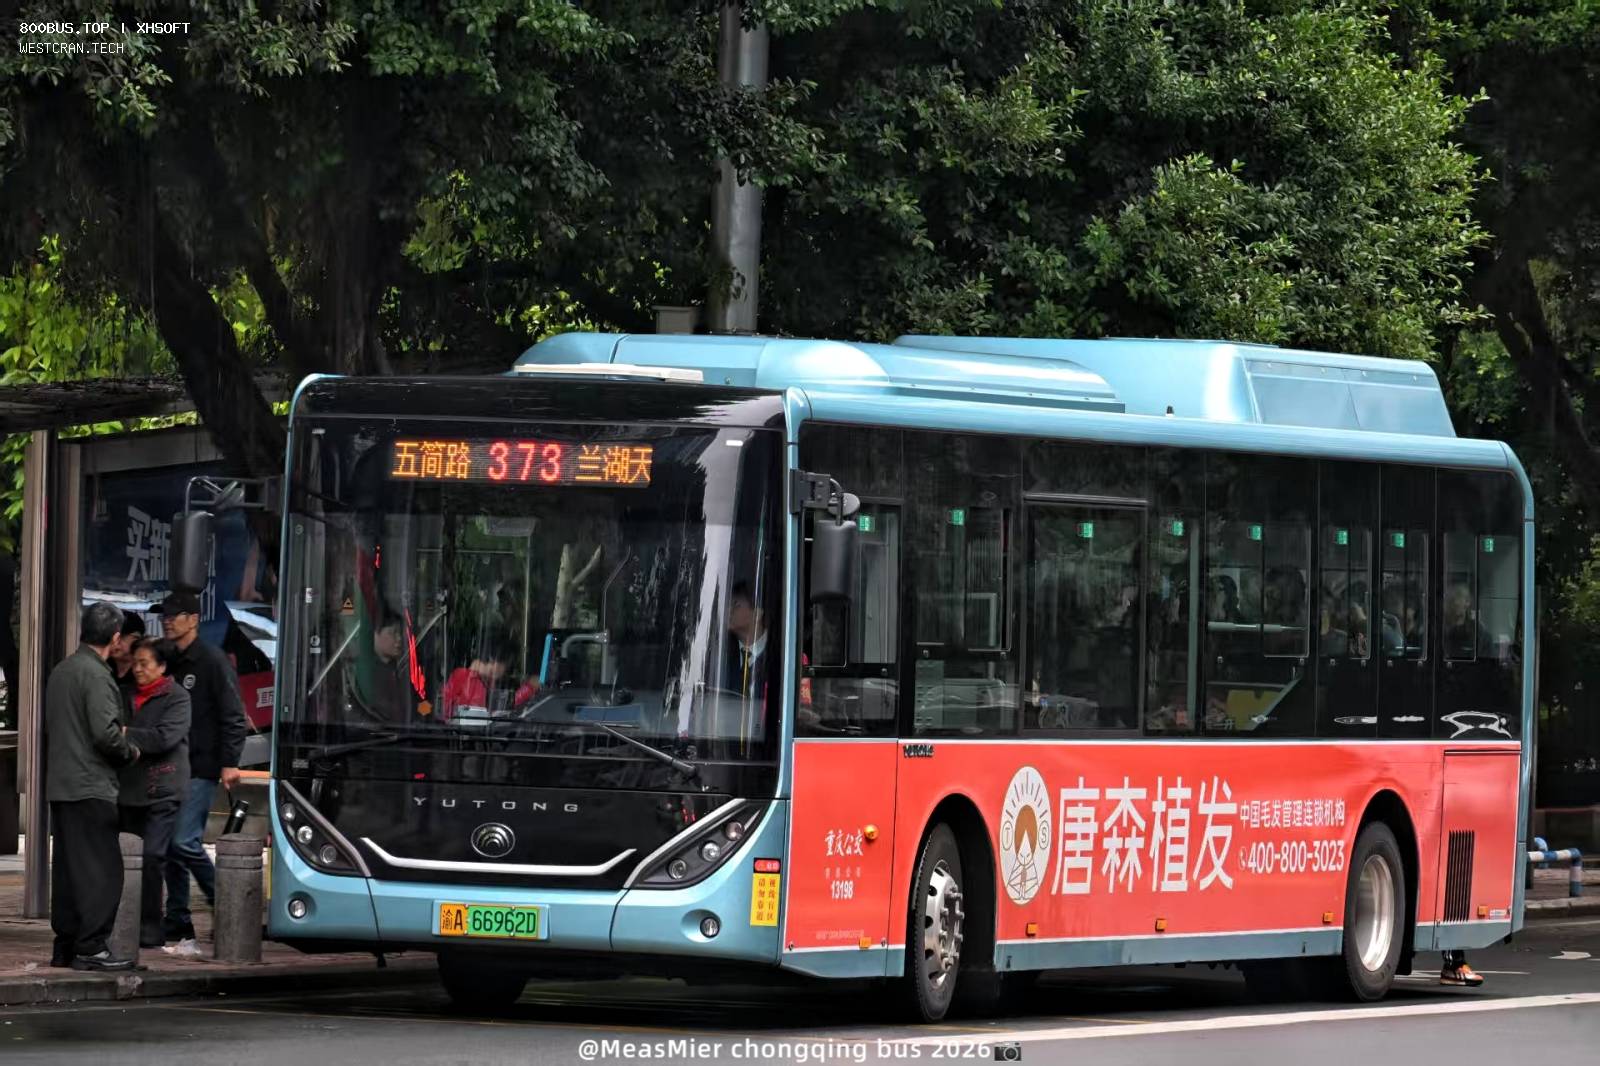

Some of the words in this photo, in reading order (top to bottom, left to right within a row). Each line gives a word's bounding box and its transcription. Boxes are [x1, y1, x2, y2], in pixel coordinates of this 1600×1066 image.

[392, 441, 471, 479] 五简路
[488, 442, 562, 481] 373
[575, 444, 653, 484] 兰湖天
[413, 797, 578, 812] YUTONG
[1240, 799, 1346, 829] 中国毛发管理连锁机构
[1051, 775, 1237, 896] 唐森植发
[1247, 840, 1345, 875] 400-800-3023
[831, 880, 854, 900] 13198
[442, 909, 464, 931] 渝A
[472, 910, 537, 934] 66962D
